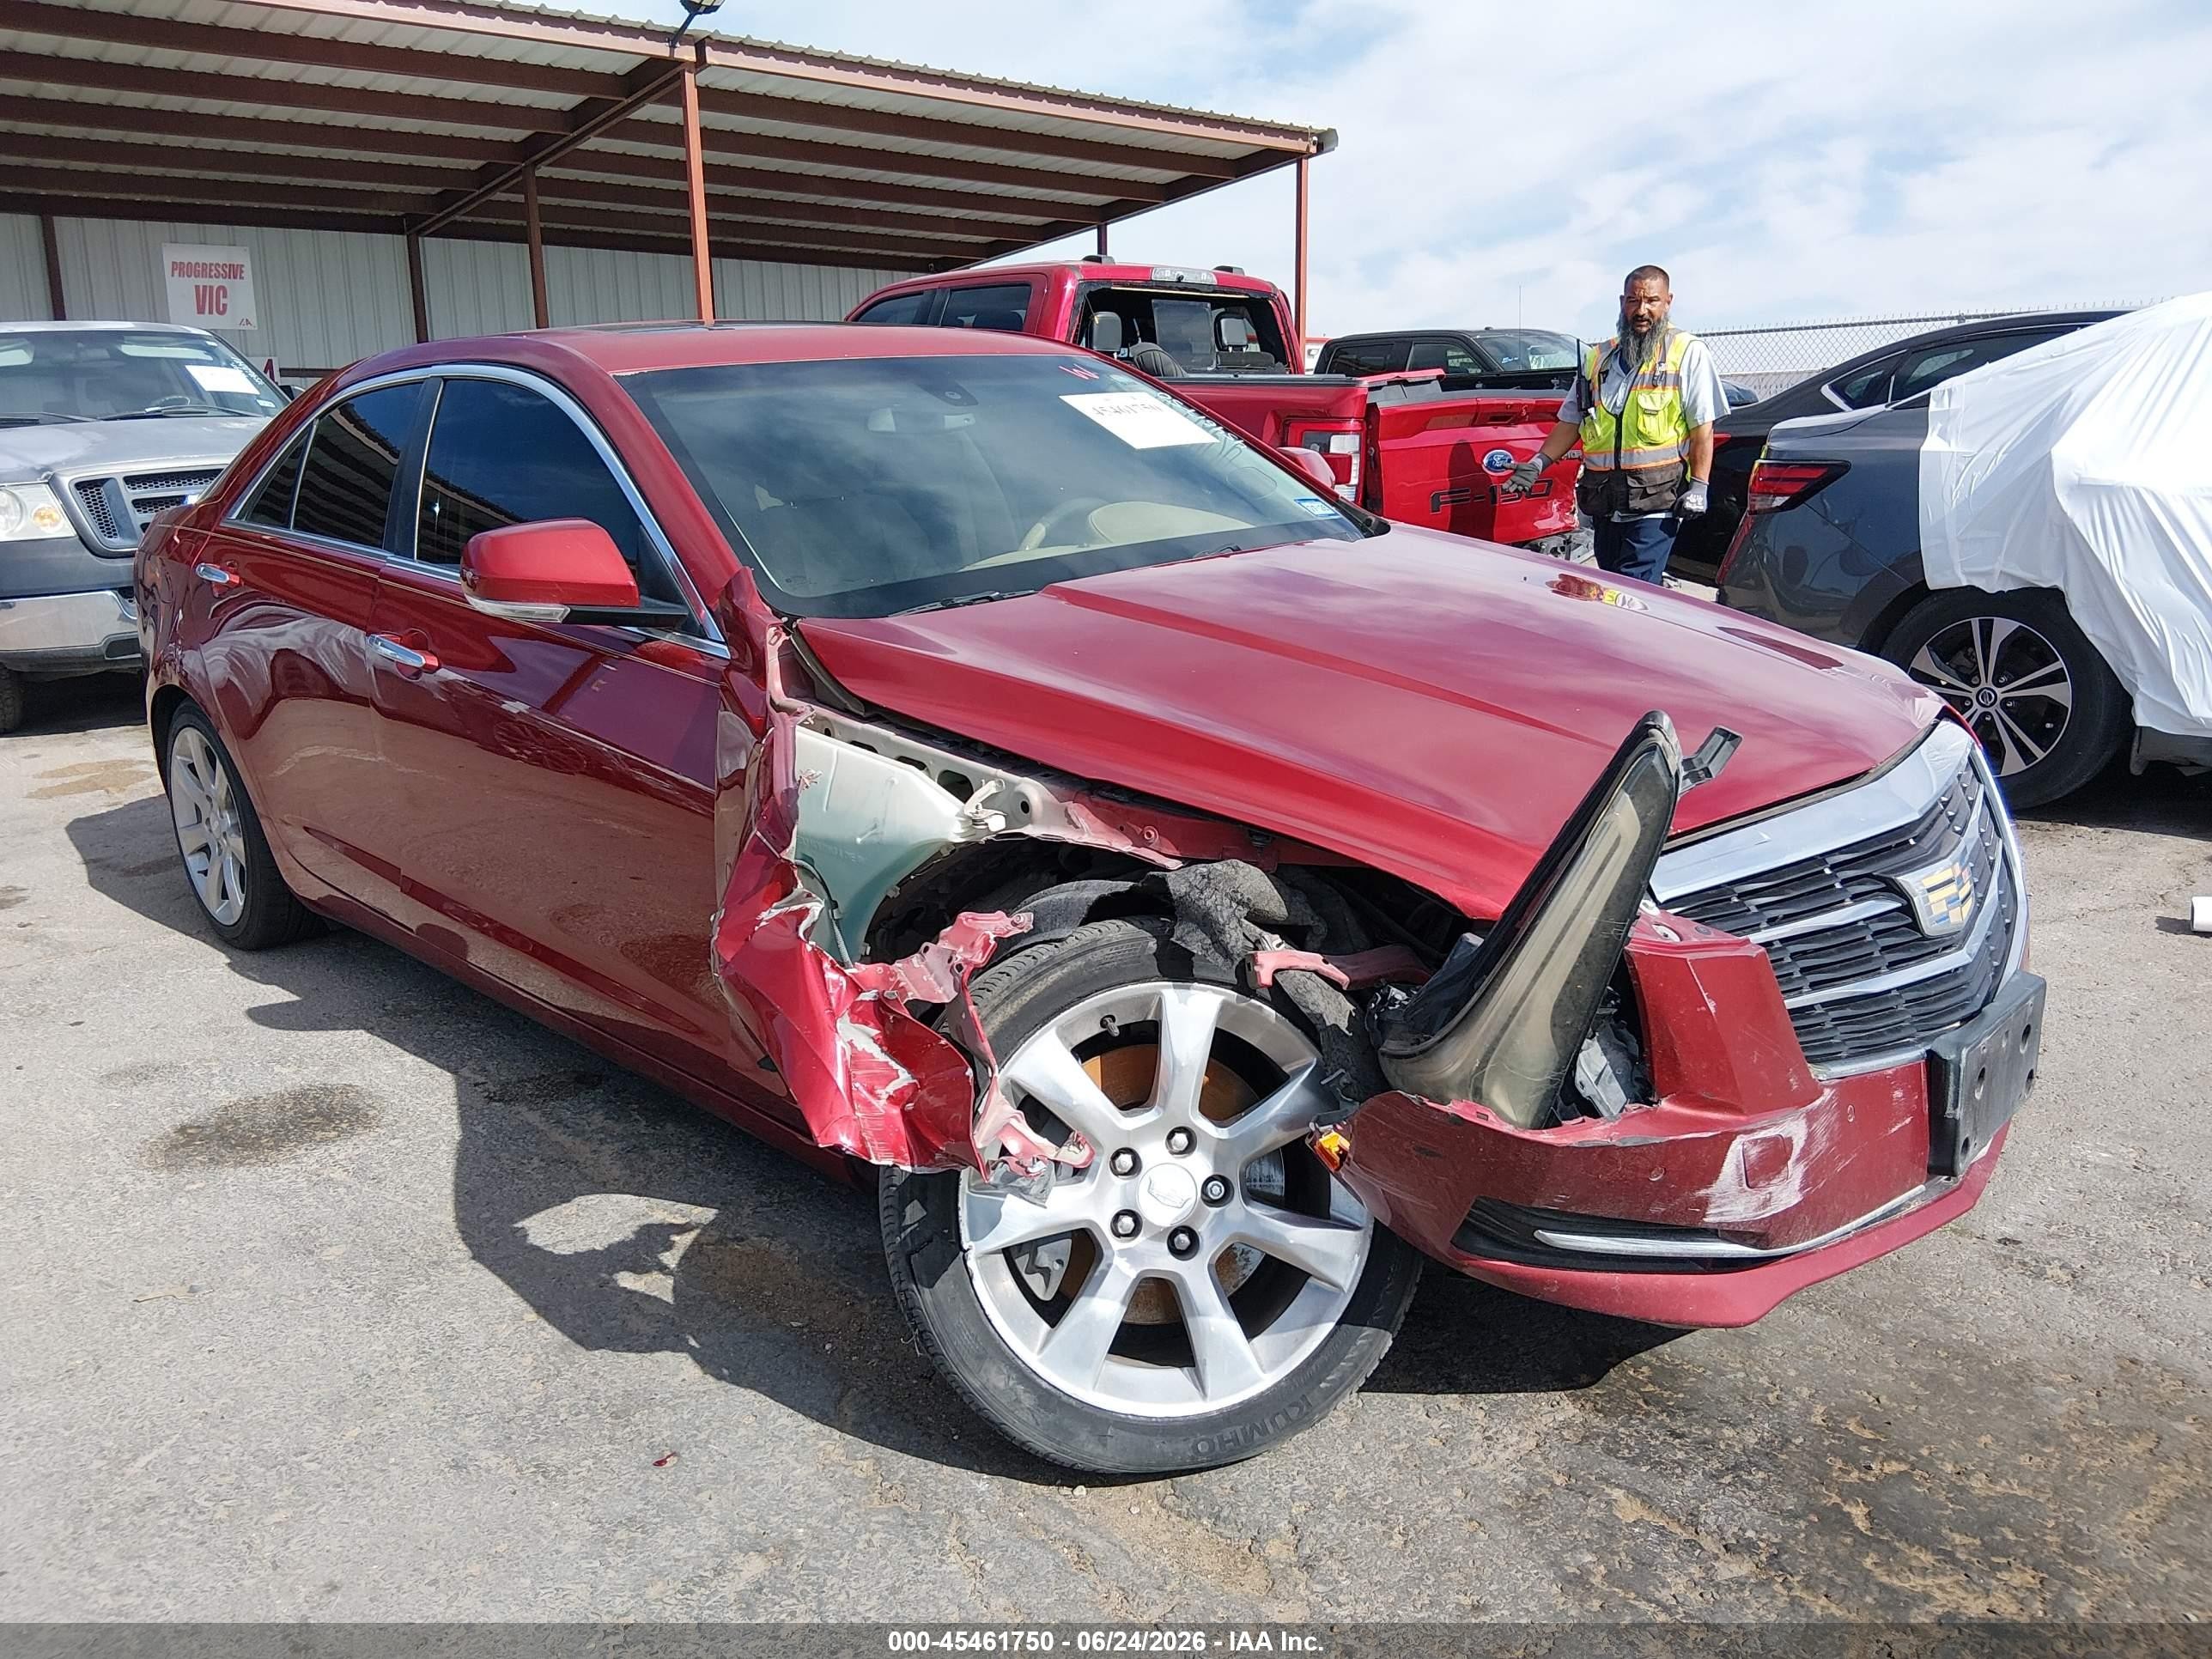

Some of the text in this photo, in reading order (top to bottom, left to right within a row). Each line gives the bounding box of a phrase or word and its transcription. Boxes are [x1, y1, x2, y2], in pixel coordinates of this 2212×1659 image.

[171, 260, 246, 280] PROGRESSIVE
[194, 284, 228, 316] VIC
[1191, 1393, 1314, 1457] KUMHO
